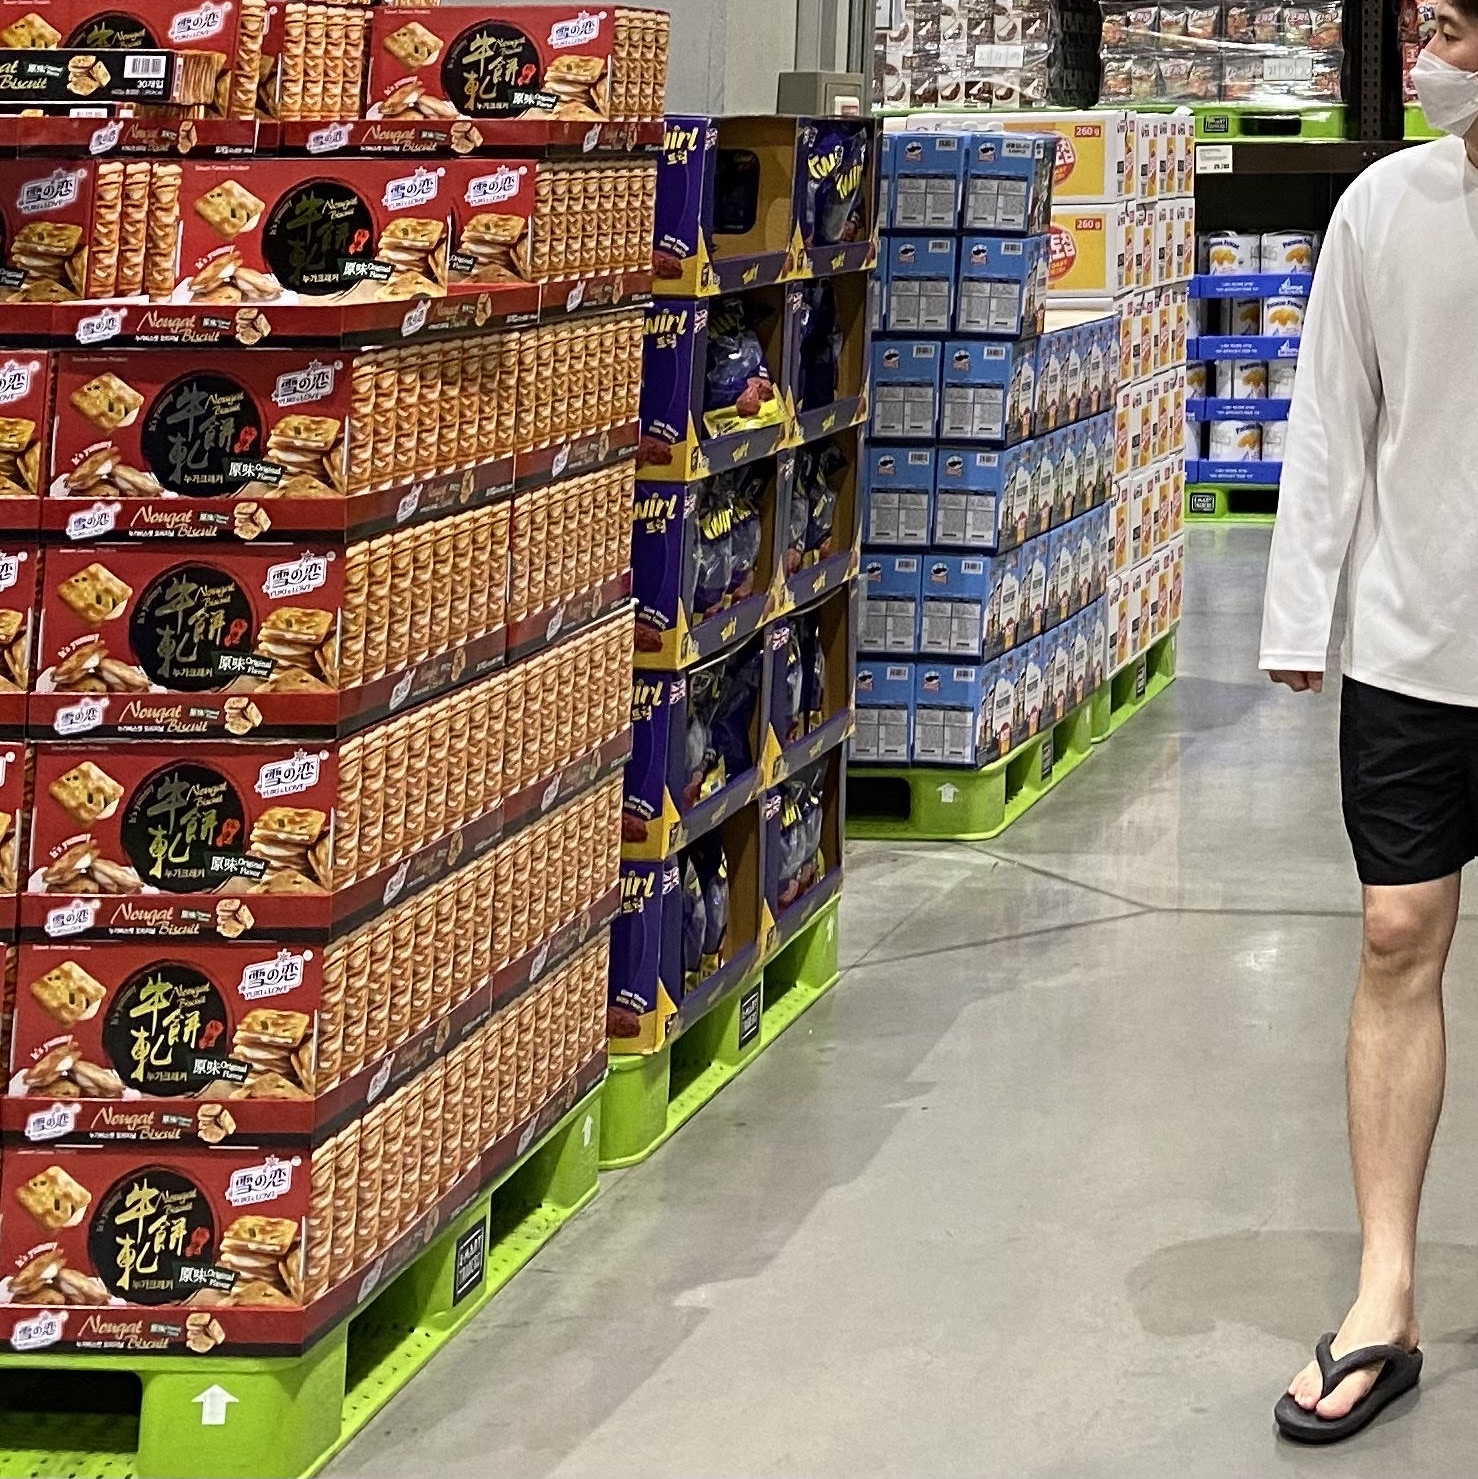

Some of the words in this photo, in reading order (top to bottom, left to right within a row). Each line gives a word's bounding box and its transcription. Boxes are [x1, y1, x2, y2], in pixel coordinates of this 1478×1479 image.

[363, 125, 415, 142] Nougat
[1076, 127, 1092, 136] 260
[1077, 220, 1093, 229] 260
[343, 260, 367, 276] 原味
[137, 311, 196, 332] Nougat
[643, 310, 687, 335] wirl
[279, 373, 332, 397] 雪の恋
[229, 461, 255, 478] 原味
[130, 505, 193, 527] Nougat
[633, 494, 677, 521] wirl
[177, 523, 218, 538] Biscuit
[271, 560, 323, 585] 雪の恋
[218, 654, 245, 671] 原味
[245, 657, 273, 668] Original
[120, 700, 182, 722] Nougat
[167, 718, 208, 733] Biscuit
[265, 763, 316, 787] 雪の恋
[211, 856, 238, 872] 原味
[110, 902, 173, 924] Nougat
[158, 921, 200, 936] Biscuit
[248, 964, 299, 988] 雪の恋
[193, 1058, 221, 1075] 原味
[220, 1061, 248, 1072] Original
[90, 1106, 154, 1129] Nougat
[139, 1125, 181, 1140] Biscuit
[235, 1169, 287, 1193] 雪の恋
[178, 1266, 207, 1283] 原味
[79, 1314, 142, 1336] Nougat
[127, 1334, 169, 1349] Biscuit
